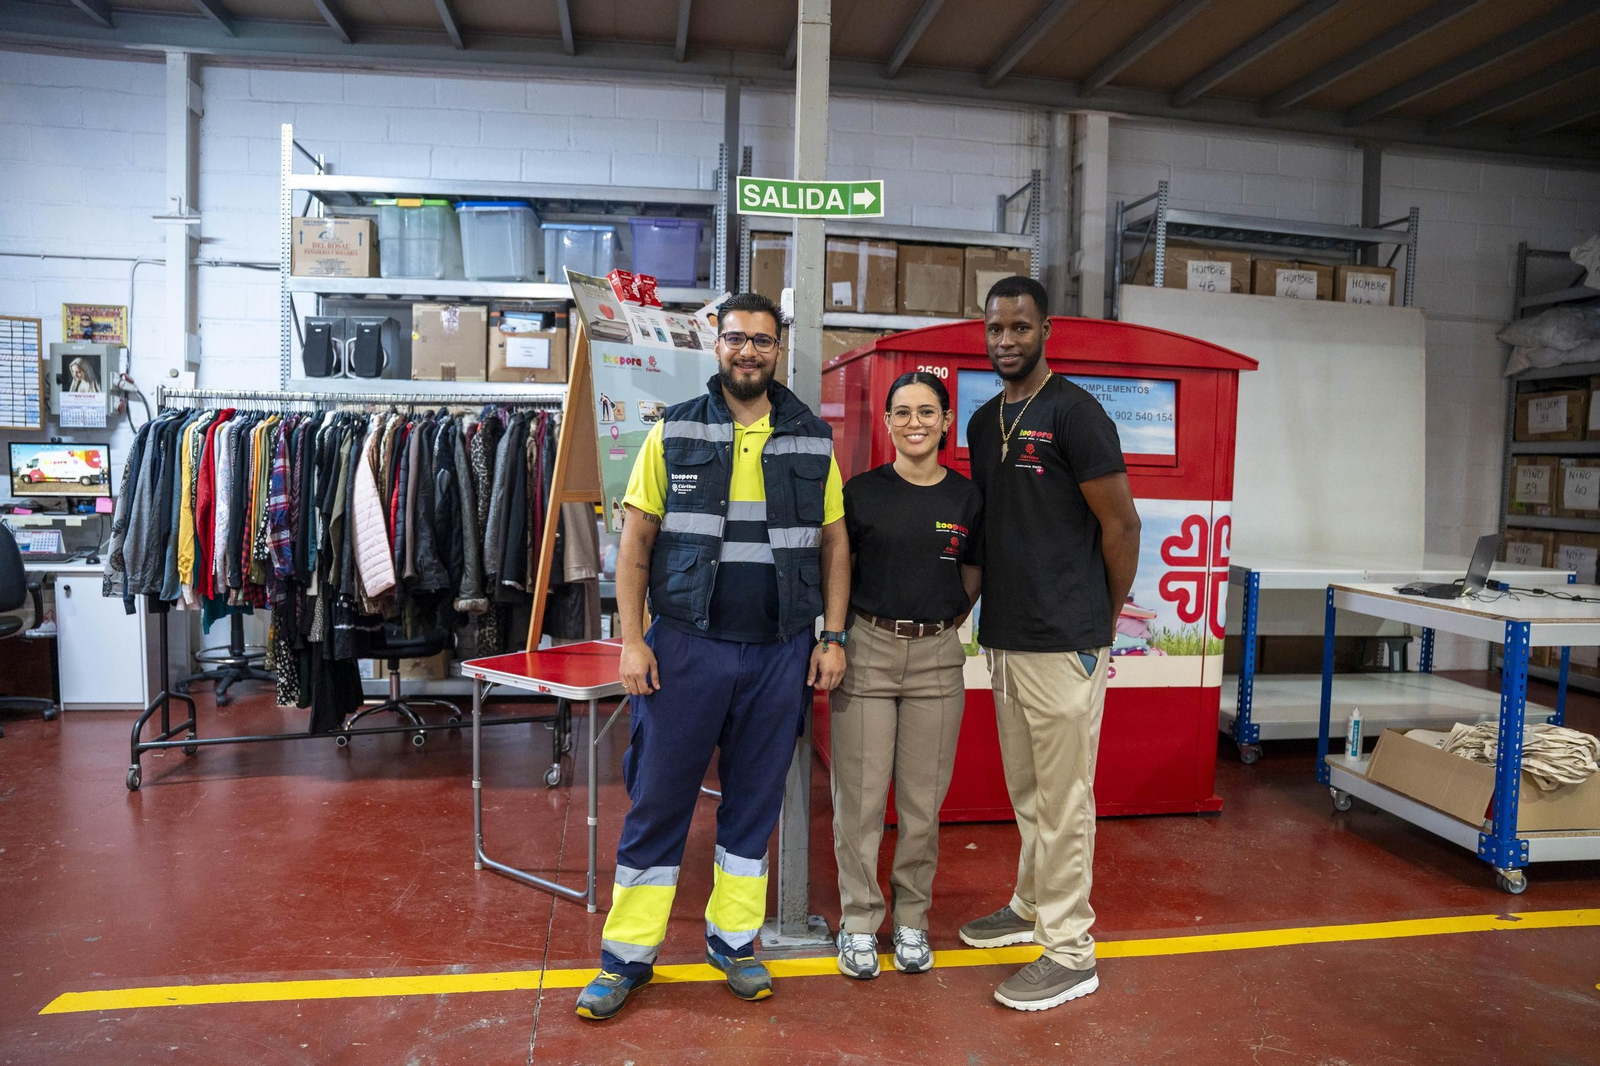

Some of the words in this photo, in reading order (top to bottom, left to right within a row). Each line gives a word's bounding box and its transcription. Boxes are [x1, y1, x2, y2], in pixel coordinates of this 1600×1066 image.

[743, 184, 845, 210] SALIDA
[1191, 264, 1226, 276] HOMBRE
[1282, 273, 1314, 285] HOMBRE
[1352, 277, 1388, 291] HOMBRE
[1199, 279, 1216, 293] 45
[1115, 411, 1132, 421] 902
[1135, 411, 1153, 422] 540
[1157, 412, 1173, 422] 154
[1524, 483, 1538, 496] 39
[1574, 485, 1588, 496] 40
